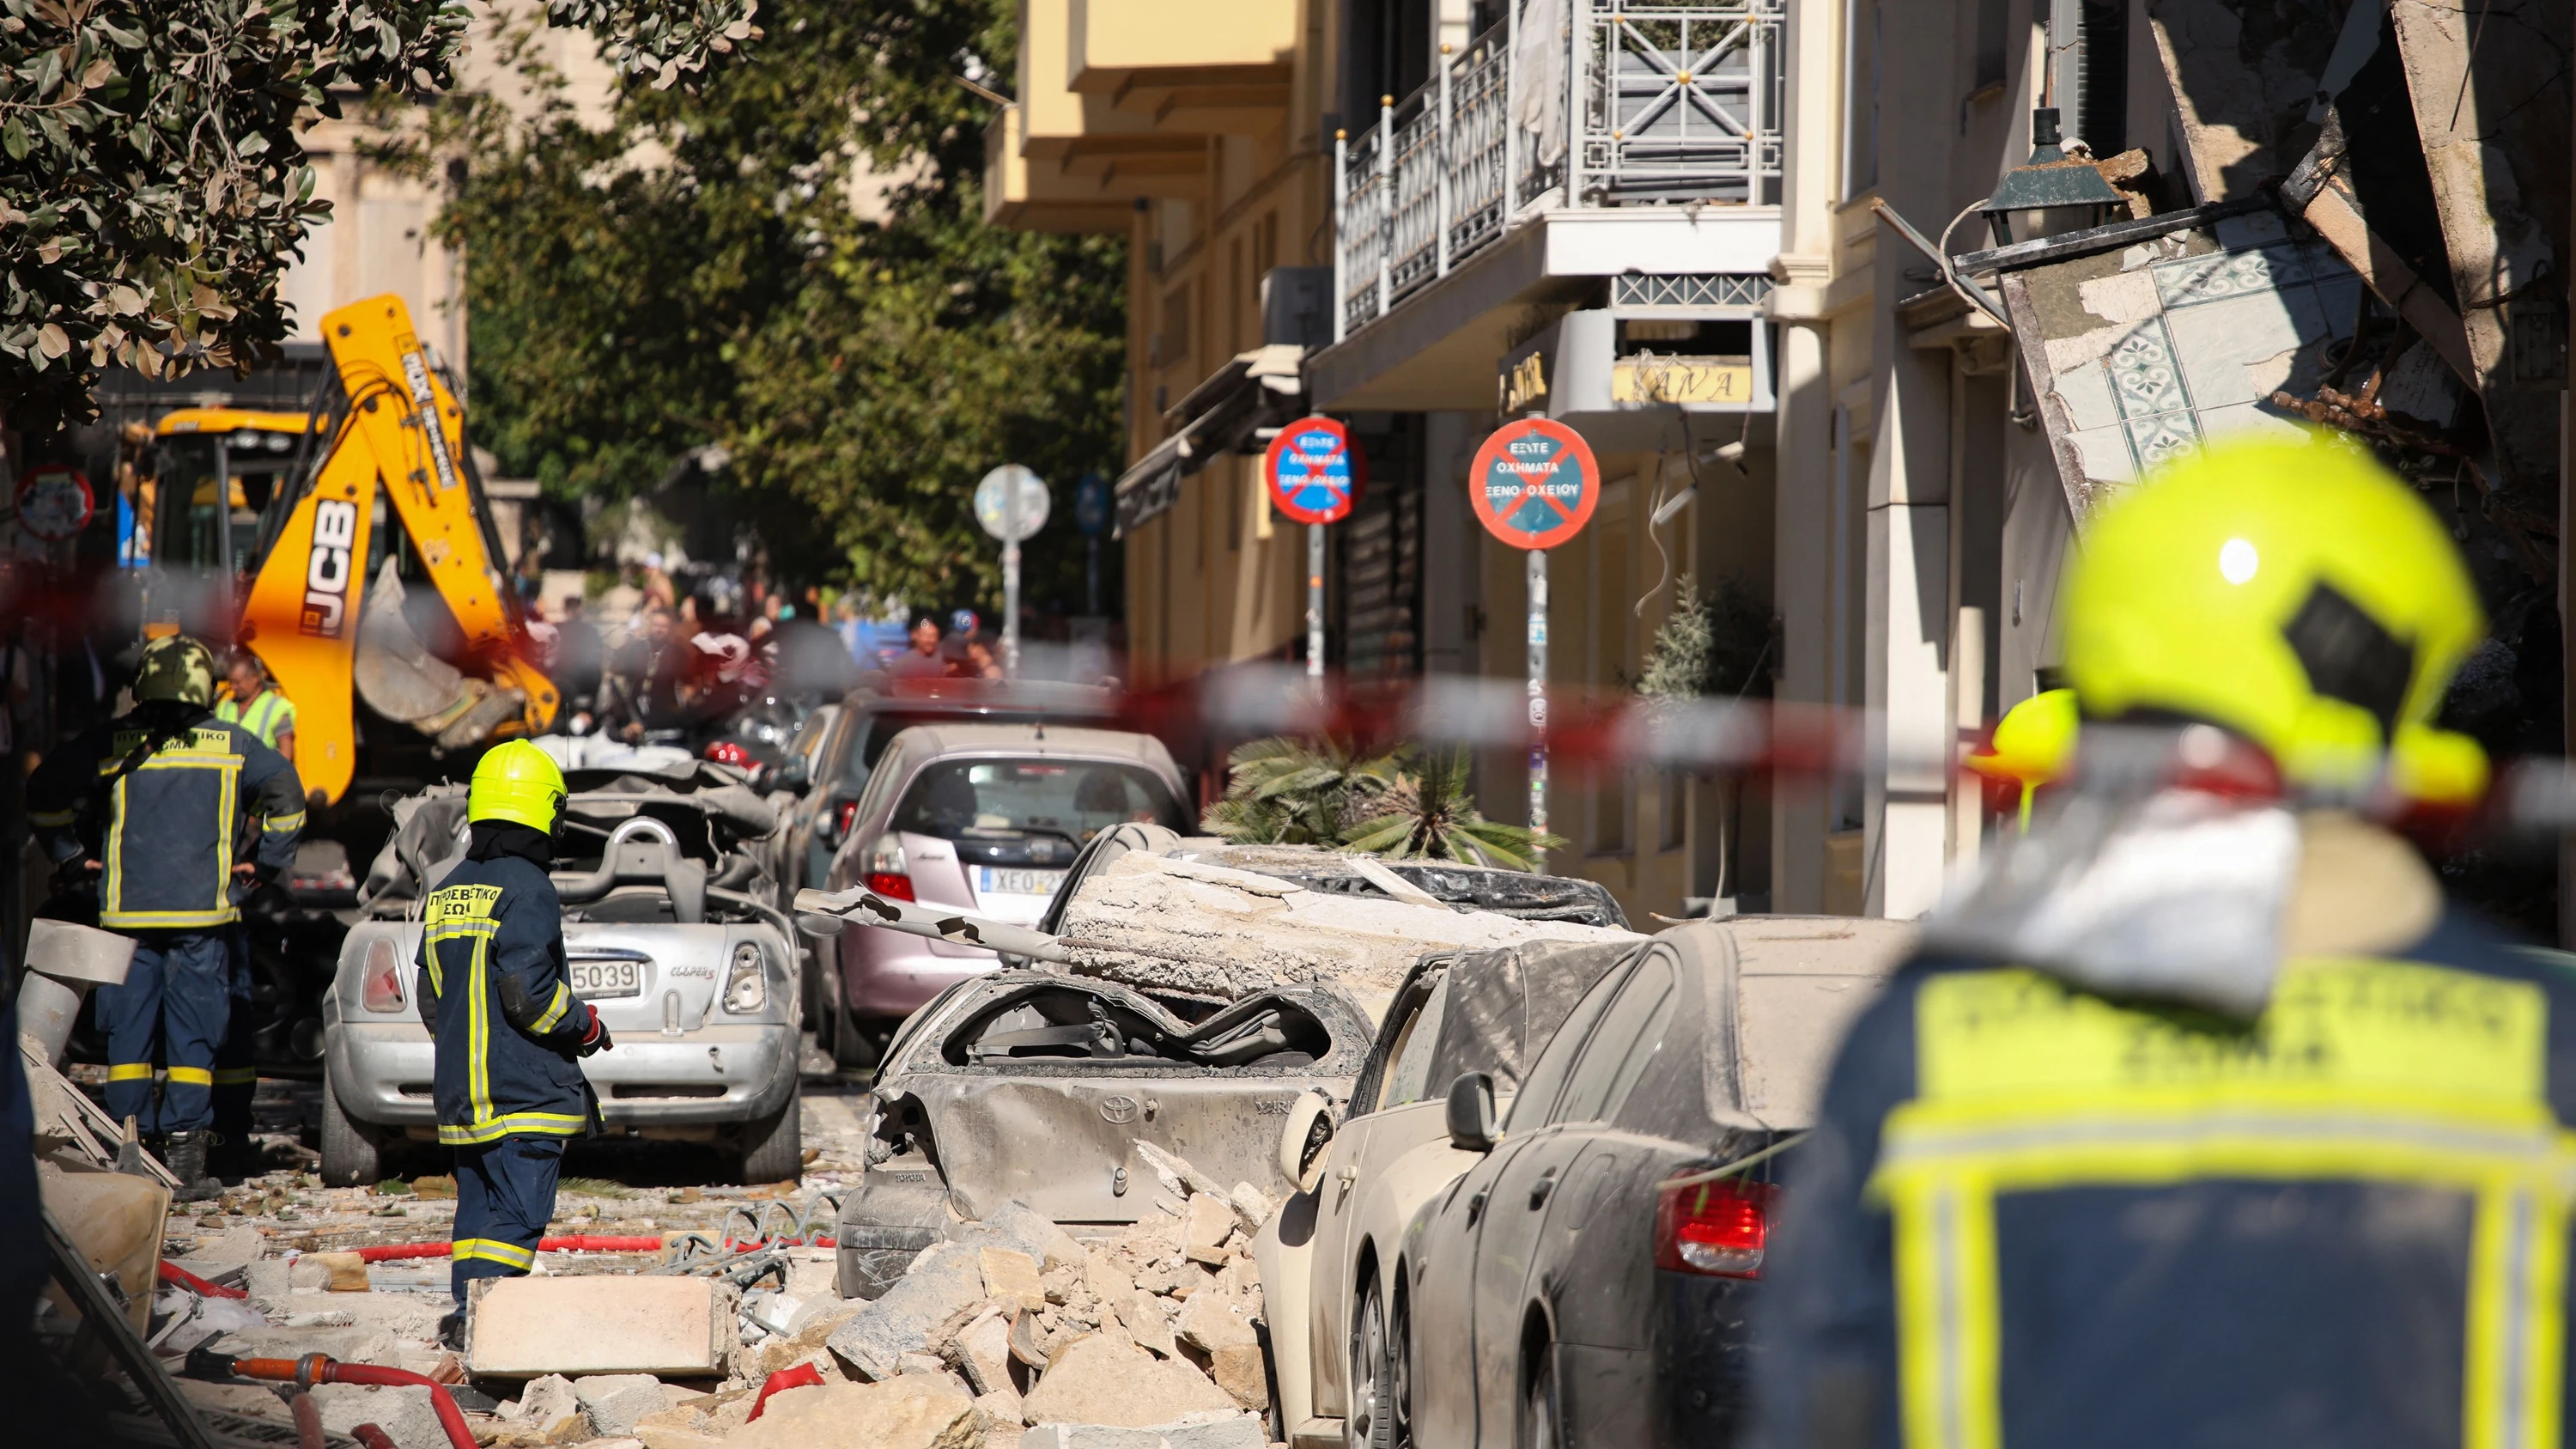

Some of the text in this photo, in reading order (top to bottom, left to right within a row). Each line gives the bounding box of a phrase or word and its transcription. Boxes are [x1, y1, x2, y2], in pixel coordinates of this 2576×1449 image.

[1496, 462, 1559, 473] ΟΧΗΜΑΤΑ
[305, 500, 356, 636] JCB
[573, 964, 634, 989] 5039
